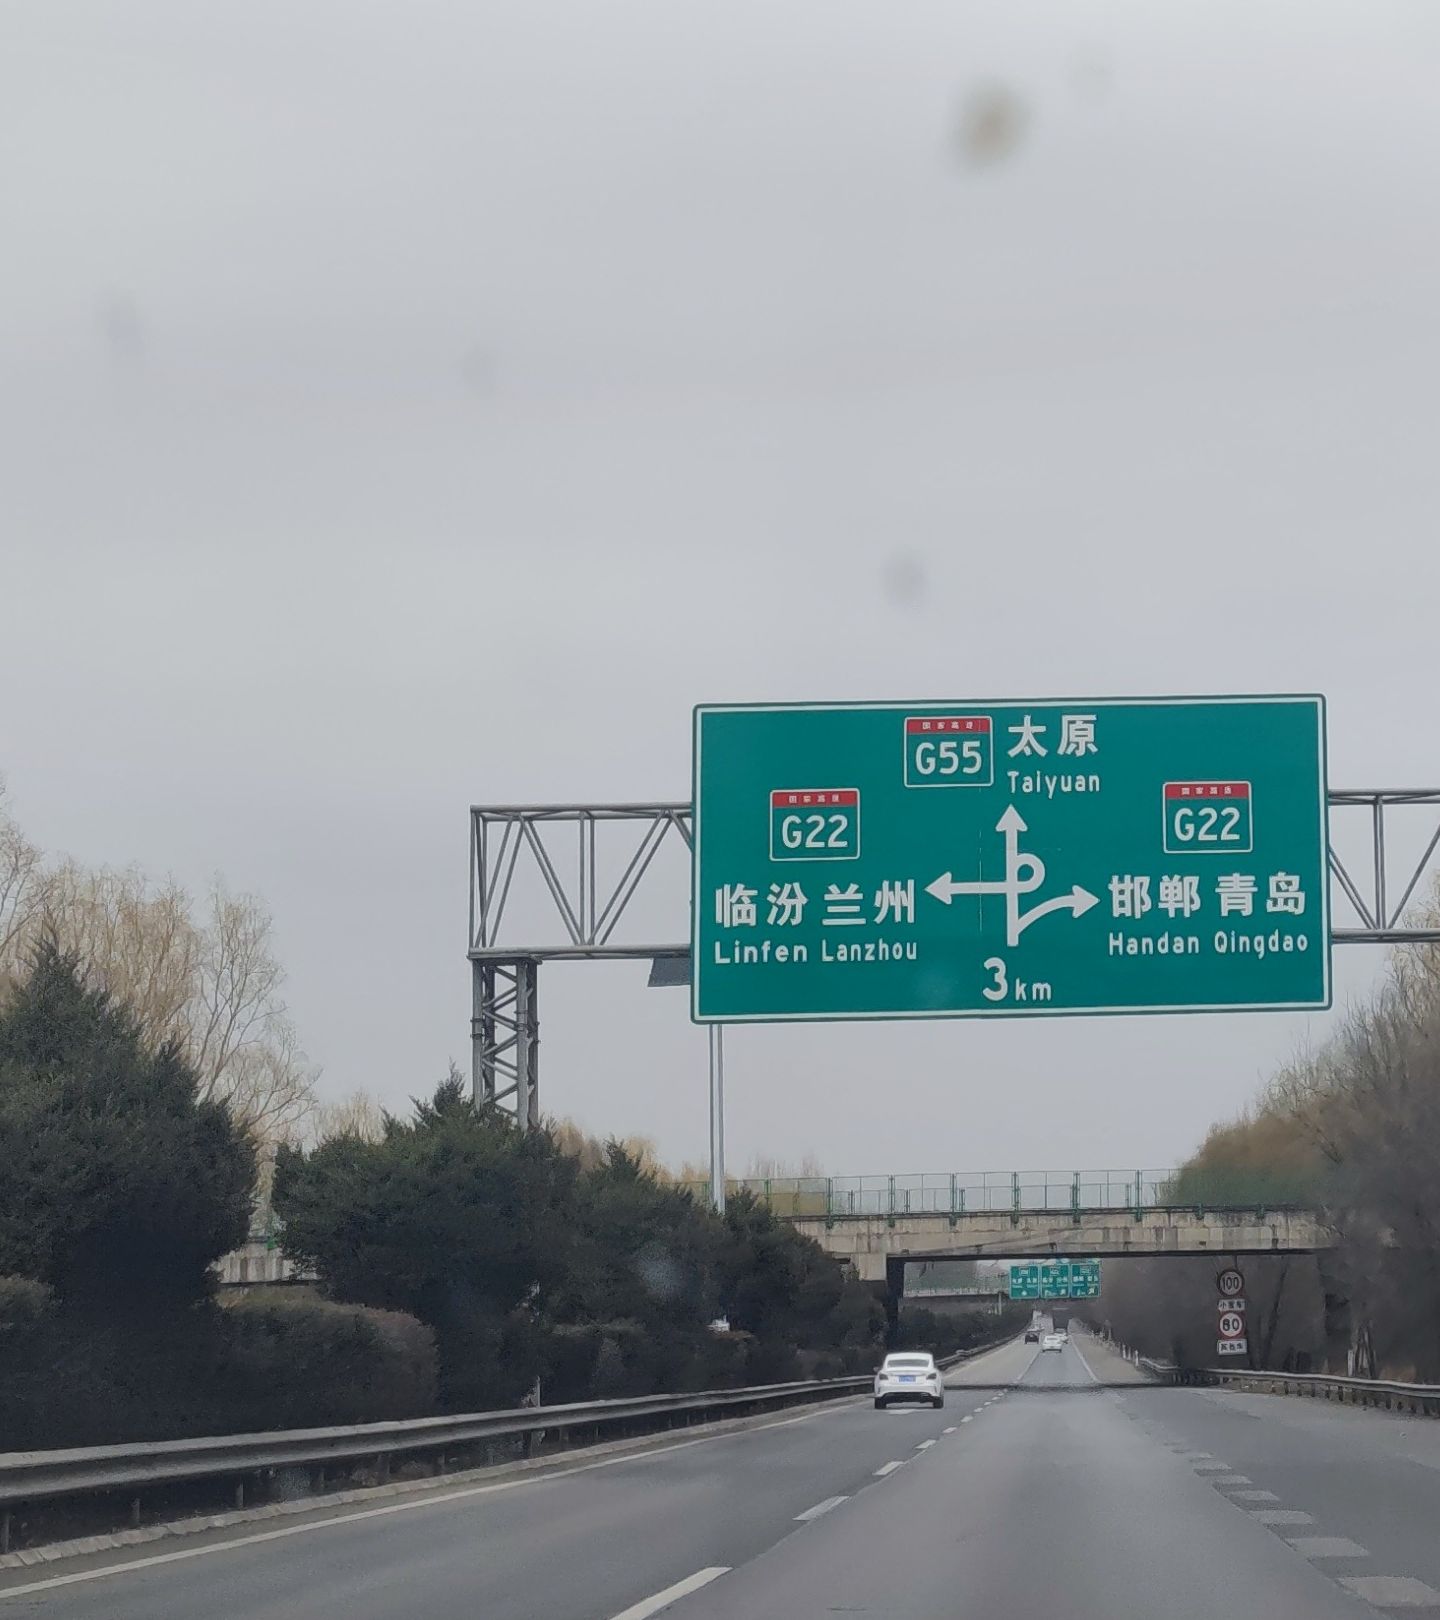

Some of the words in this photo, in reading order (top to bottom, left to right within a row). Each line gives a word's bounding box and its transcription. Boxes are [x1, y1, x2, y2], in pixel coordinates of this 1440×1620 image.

[1007, 714, 1098, 758] 太原
[915, 740, 982, 775] G55
[1007, 770, 1100, 799] Taiyuan
[782, 814, 848, 849] G22
[1174, 807, 1240, 841] G22
[715, 882, 808, 928] 临汾
[822, 879, 915, 926] 兰州
[1108, 874, 1201, 919] 邯郸
[1215, 871, 1306, 917] 青岛
[714, 940, 807, 964] Linfen
[822, 938, 917, 962] Lanzhou
[1109, 932, 1199, 955] Handan
[1214, 929, 1308, 959] Qingdao
[1222, 1276, 1239, 1291] 100
[1222, 1318, 1240, 1332] 80
